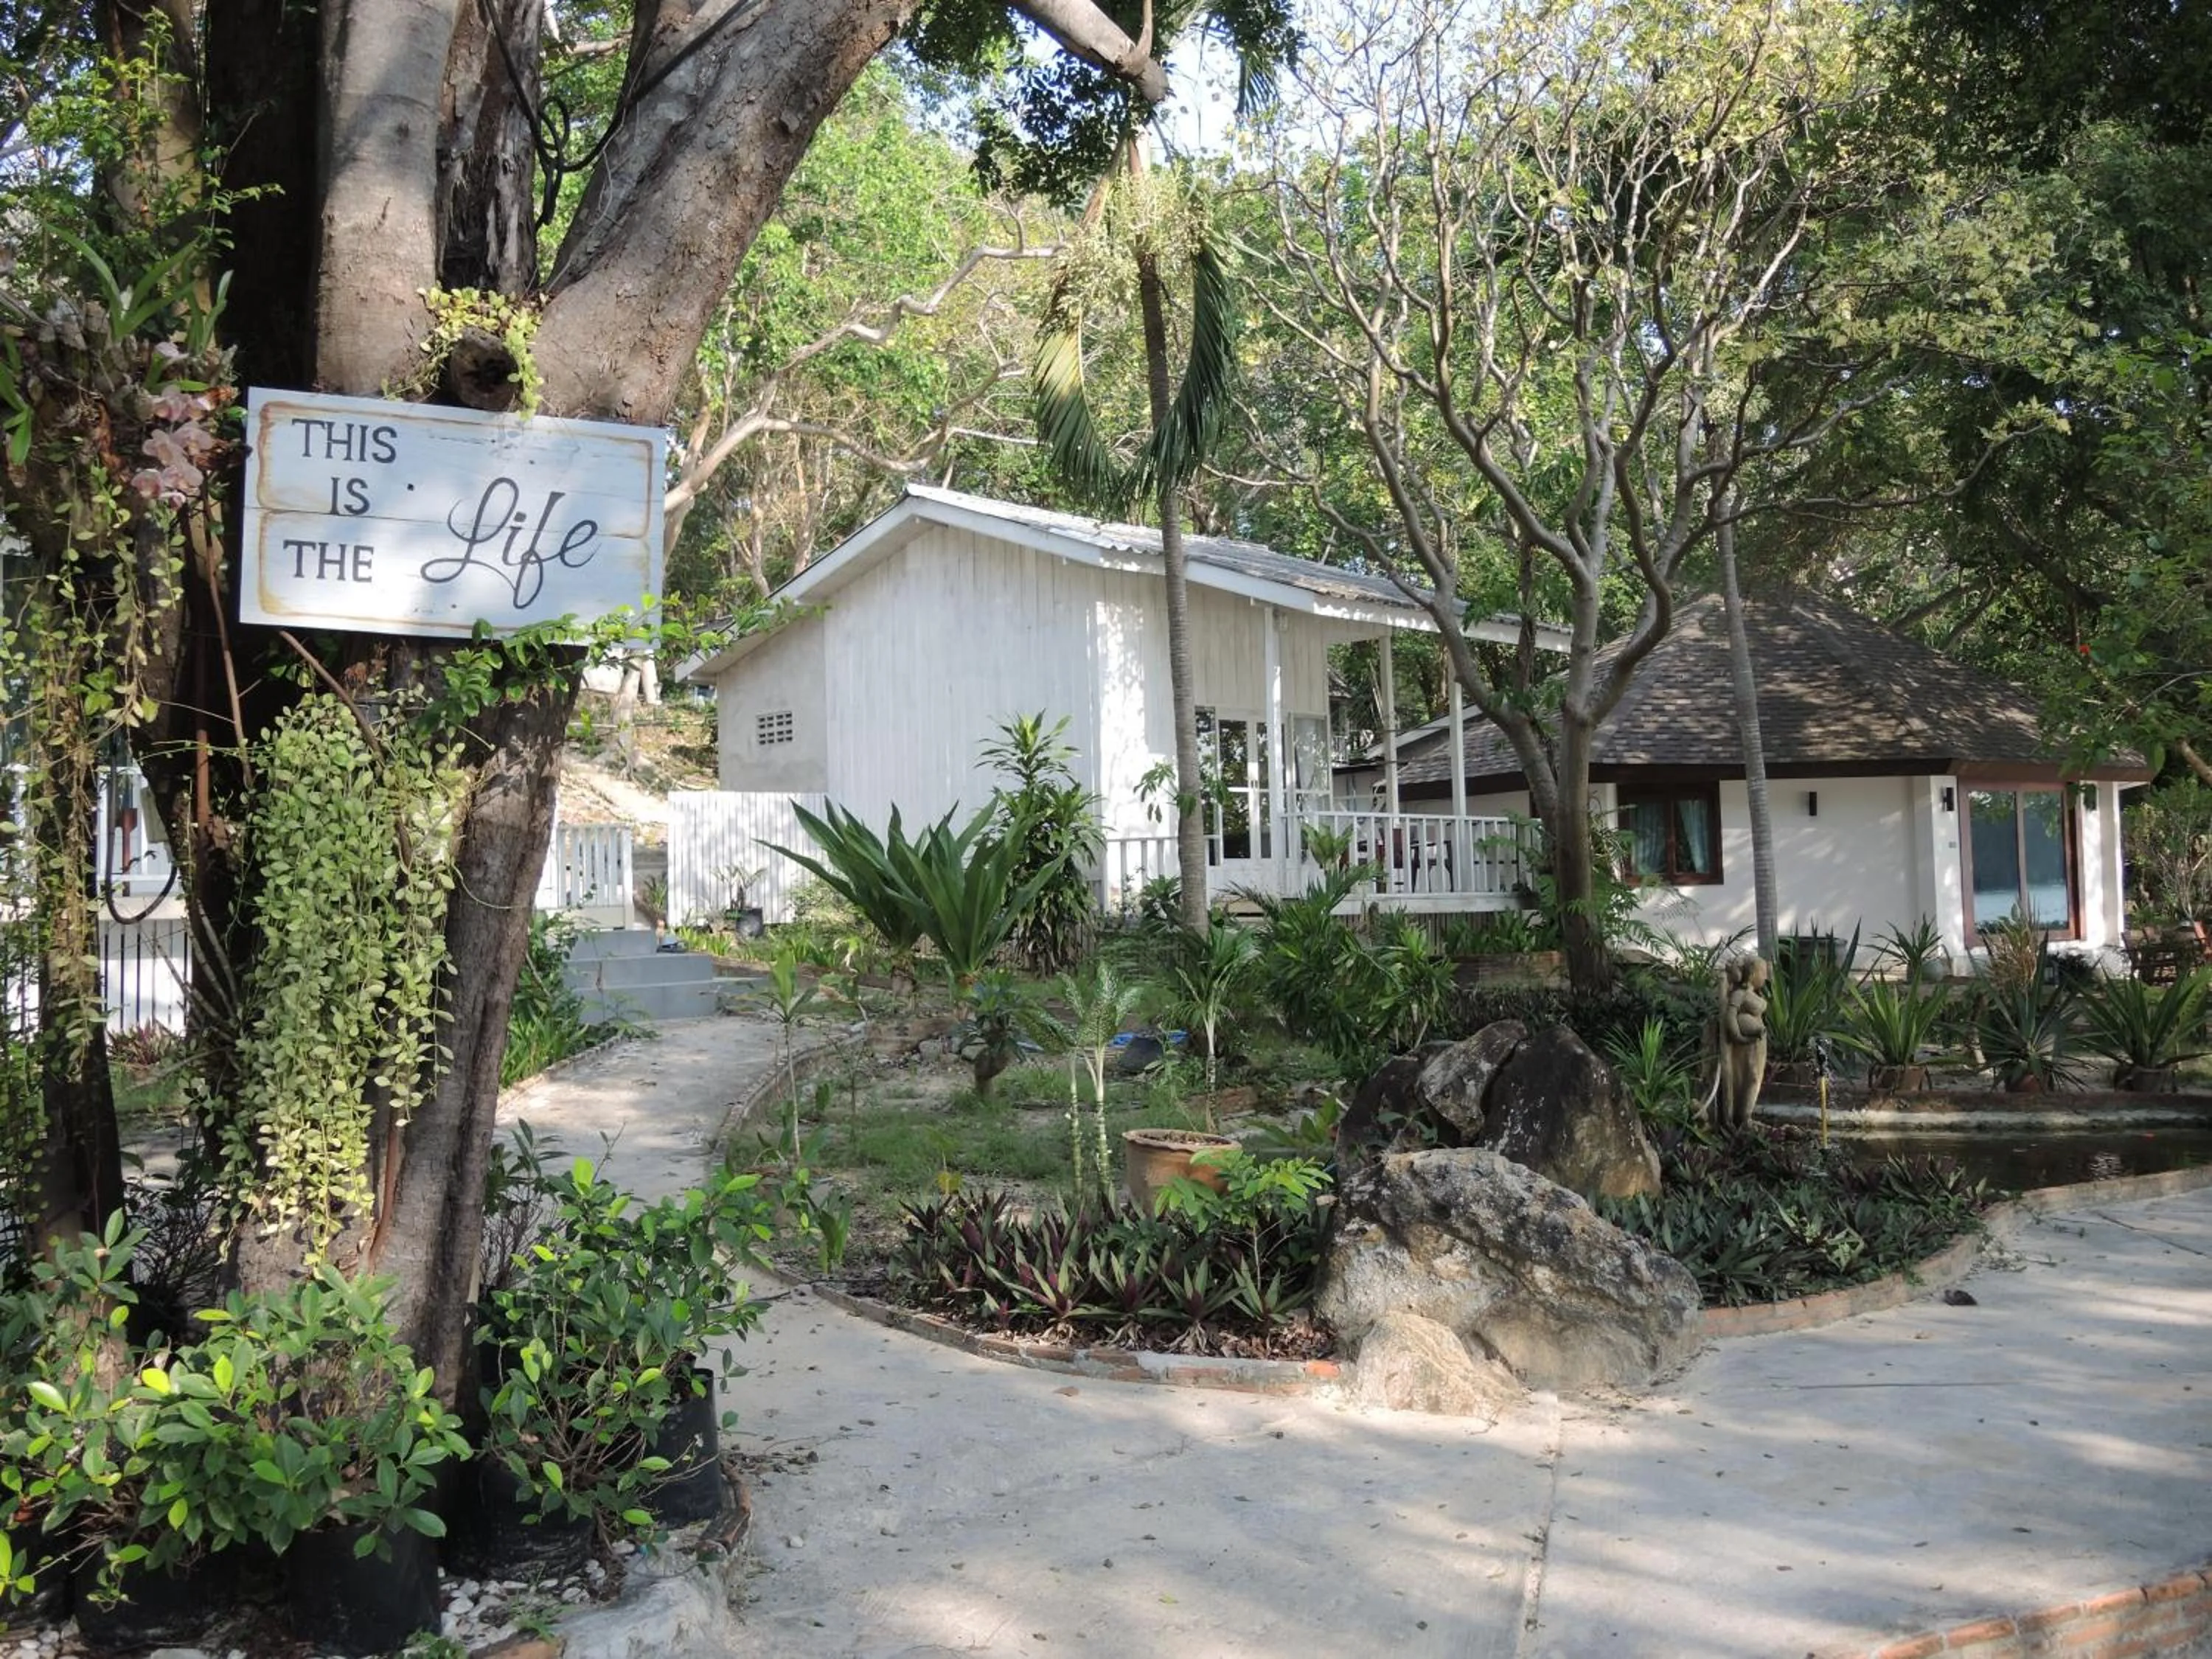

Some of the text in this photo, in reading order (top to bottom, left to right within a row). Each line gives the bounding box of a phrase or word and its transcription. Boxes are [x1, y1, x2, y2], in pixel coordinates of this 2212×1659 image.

[292, 418, 397, 463] THIS
[330, 477, 370, 515] IS
[283, 540, 374, 582] THE
[420, 477, 601, 609] Life
